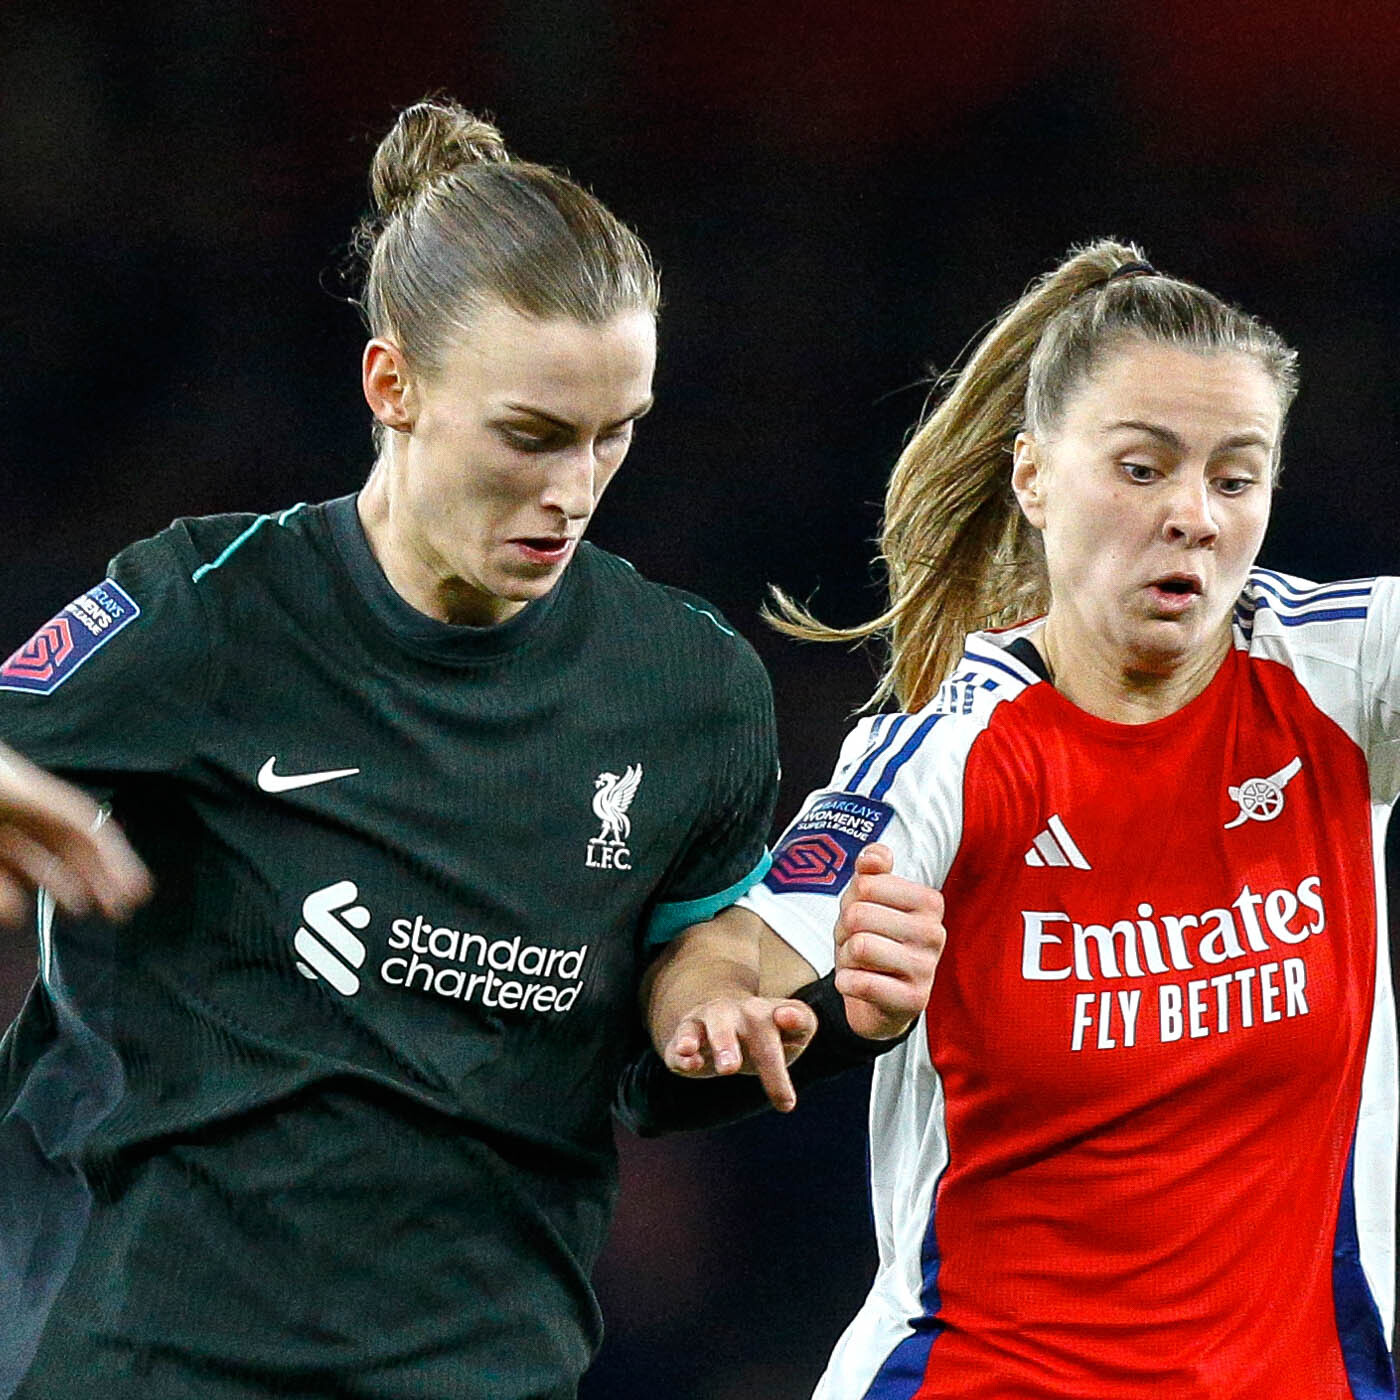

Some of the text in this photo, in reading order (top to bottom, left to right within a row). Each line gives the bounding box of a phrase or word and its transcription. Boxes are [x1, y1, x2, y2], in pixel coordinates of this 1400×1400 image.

[803, 810, 875, 833] WOMEN'S
[826, 821, 870, 841] LEAGUE
[388, 915, 588, 979] standard
[1020, 876, 1326, 981] Emirates
[380, 953, 584, 1012] chartered
[1071, 957, 1310, 1051] FLY BETTER
